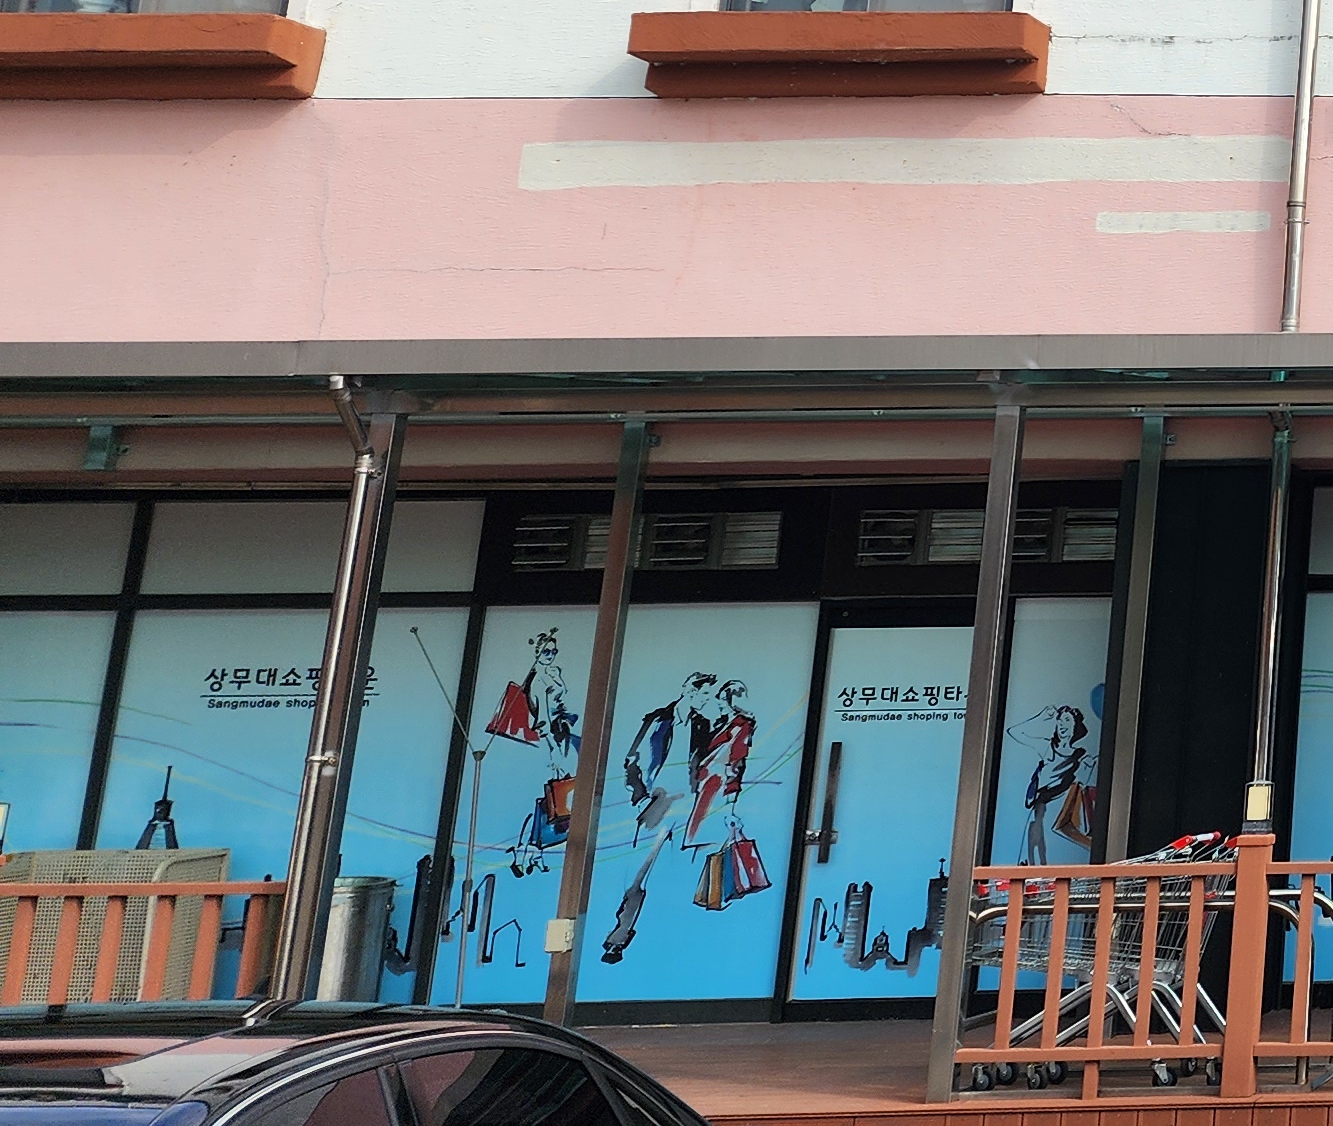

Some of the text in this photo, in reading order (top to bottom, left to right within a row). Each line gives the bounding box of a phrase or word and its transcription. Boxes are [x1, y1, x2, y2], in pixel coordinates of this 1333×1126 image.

[838, 685, 968, 708] 상무대쇼핑타
[207, 698, 281, 711] Sangmudae
[841, 712, 903, 723] Sangmudae
